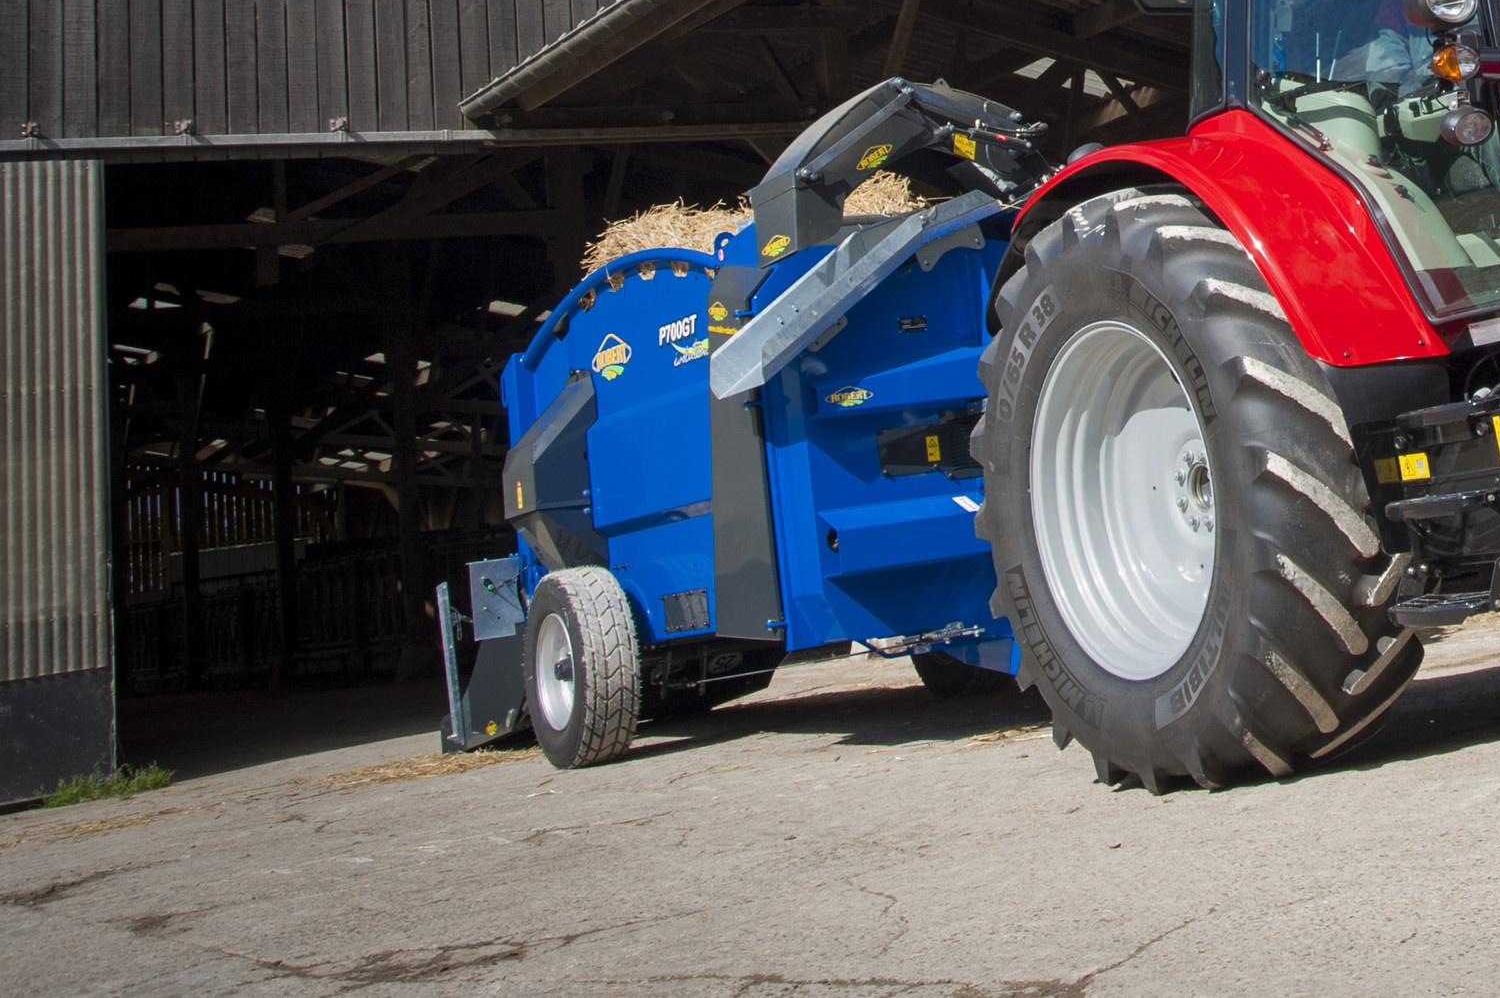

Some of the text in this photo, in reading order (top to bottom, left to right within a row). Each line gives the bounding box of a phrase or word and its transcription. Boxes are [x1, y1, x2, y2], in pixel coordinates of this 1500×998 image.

[658, 313, 698, 348] P700GT
[1018, 321, 1037, 350] R
[1032, 293, 1056, 328] 38
[596, 343, 627, 367] ROBERT
[830, 389, 868, 402] ROBERT
[1006, 571, 1085, 710] MICHELIN
